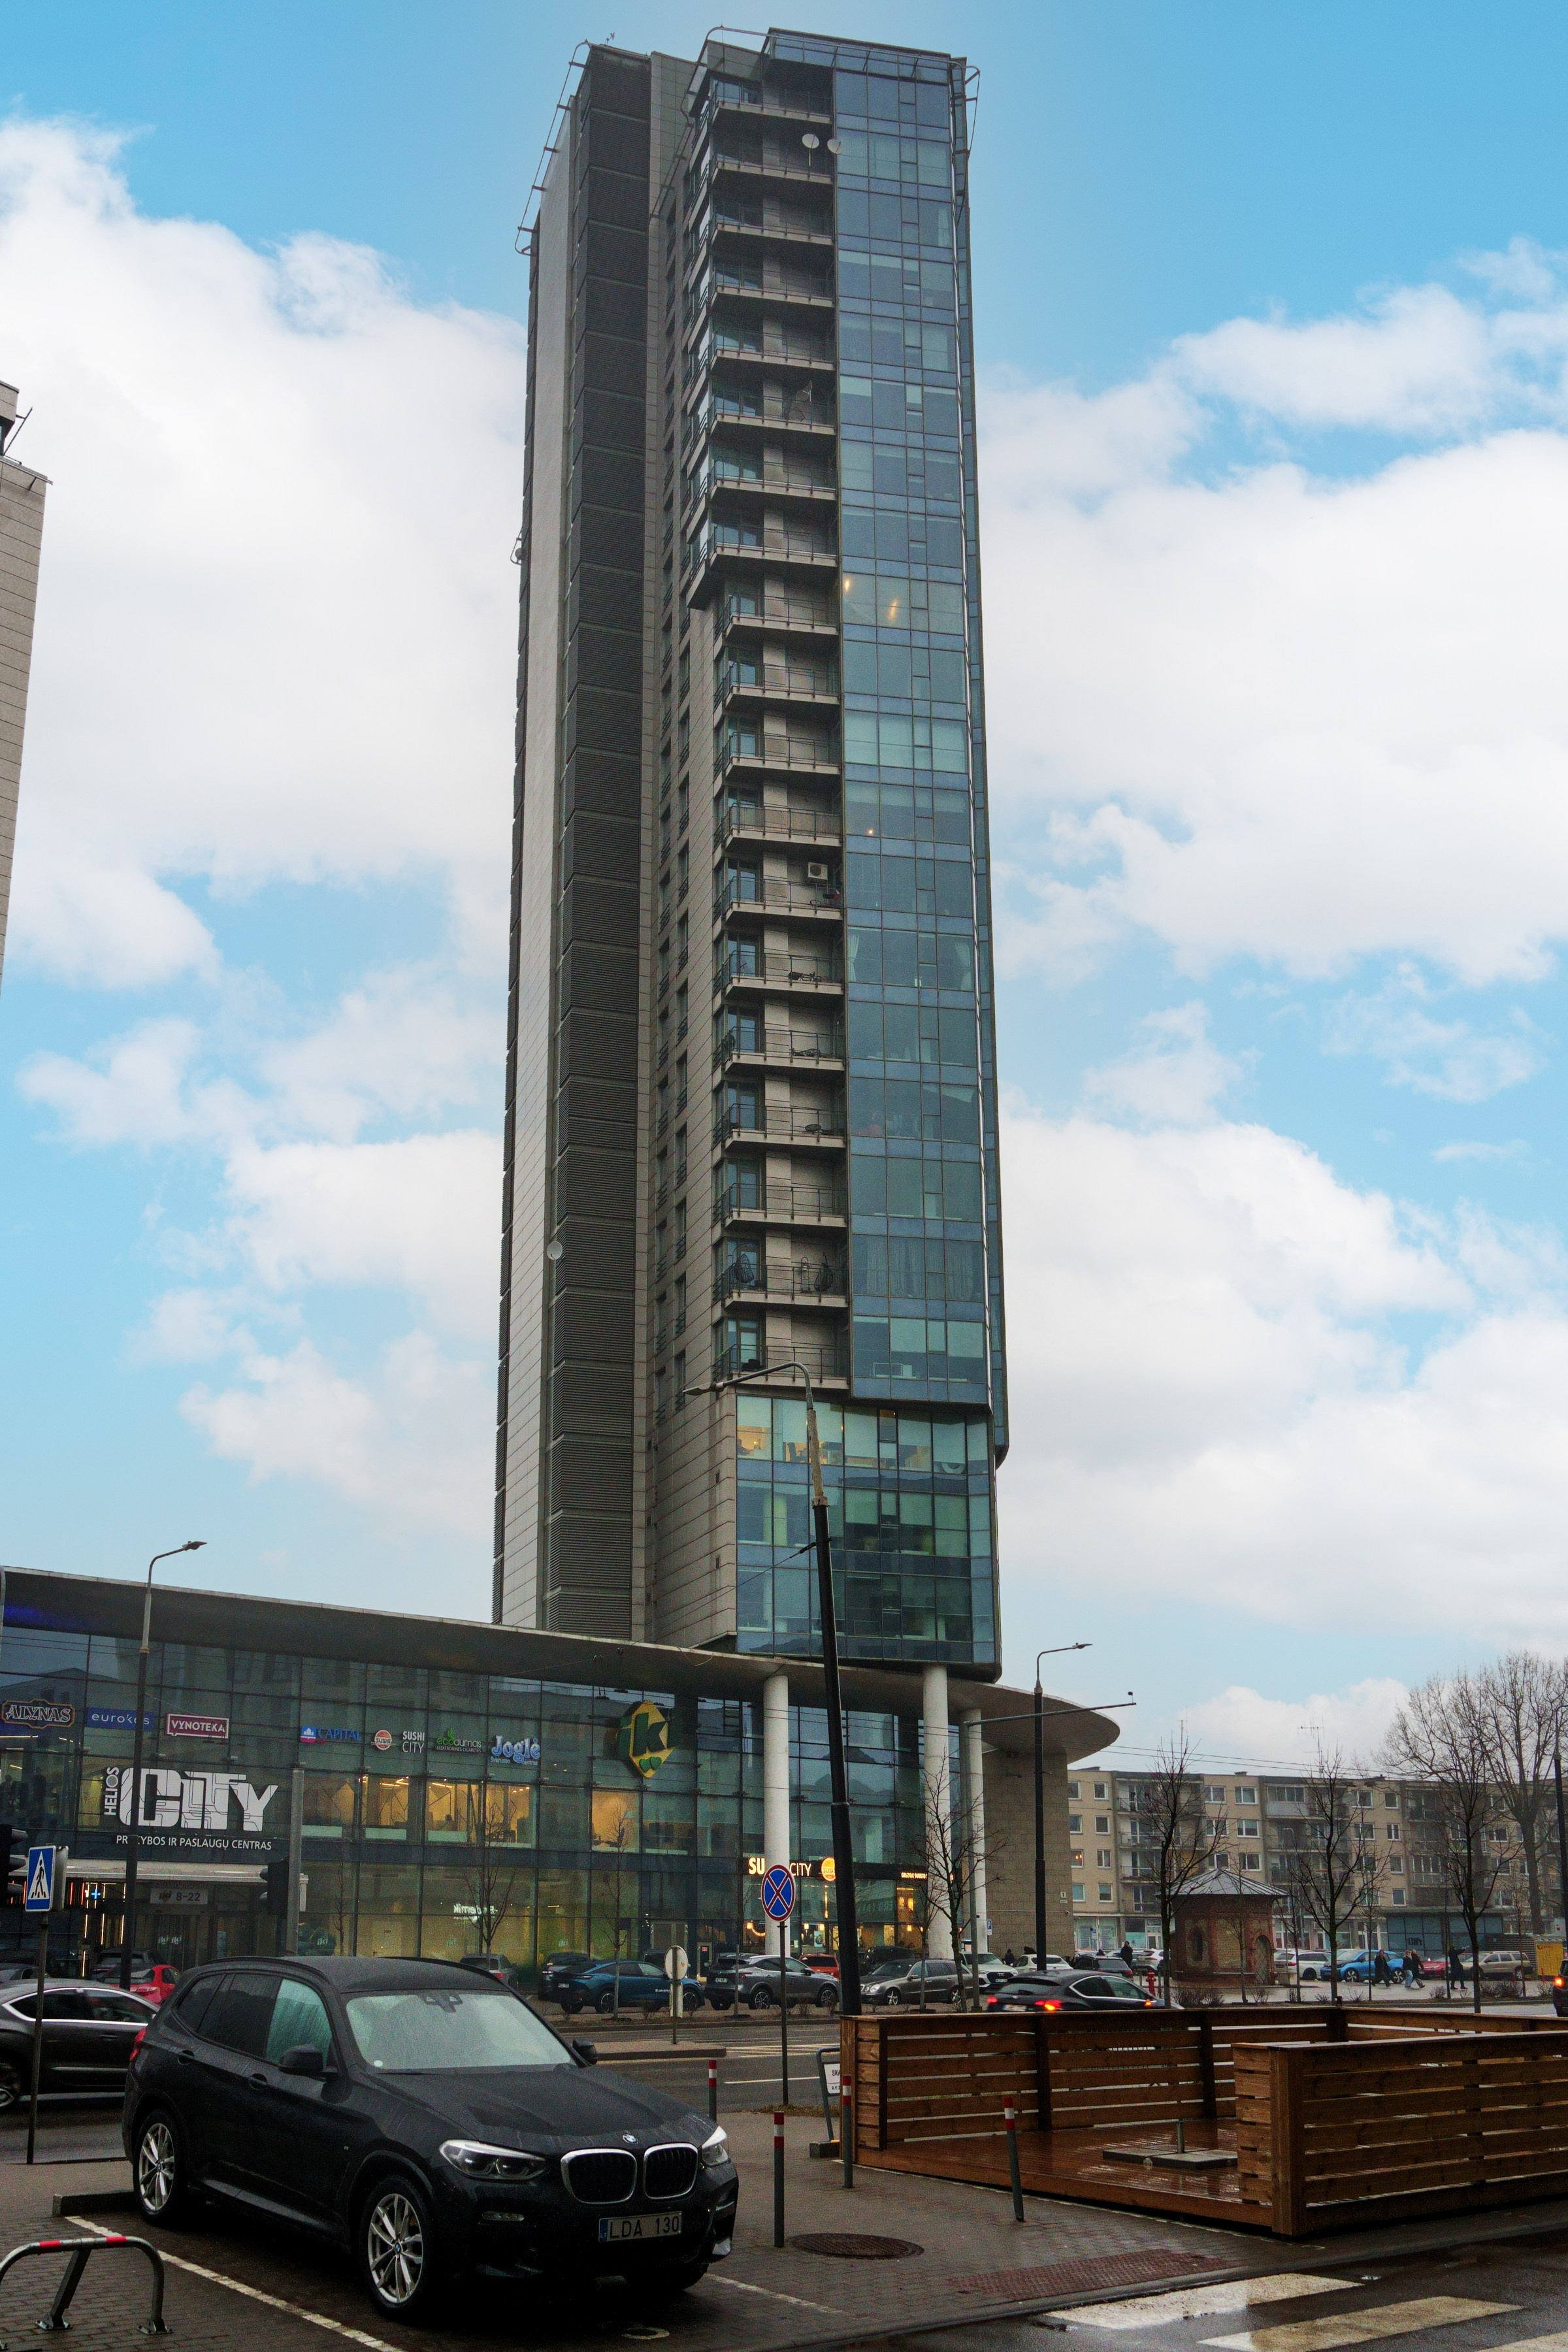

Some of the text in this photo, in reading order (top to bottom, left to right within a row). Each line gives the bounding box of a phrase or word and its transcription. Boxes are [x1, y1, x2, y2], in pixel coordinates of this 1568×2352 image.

[6, 1705, 71, 1722] ALYNAS
[171, 1720, 225, 1733] VYNOTEKA
[318, 1727, 361, 1741] CAPITAL
[402, 1731, 425, 1741] SUSHI
[436, 1737, 482, 1748] ecodumas
[402, 1741, 425, 1754] CITY
[491, 1735, 540, 1763] Joglė
[104, 1767, 120, 1816] HELIOS
[119, 1767, 278, 1832] CITY
[116, 1835, 272, 1850] PRYBOS IR PASLAUGŲ CENTRAS
[789, 1862, 811, 1877] CITY
[176, 1891, 201, 1902] 8-22
[610, 2215, 679, 2239] LDA 130
